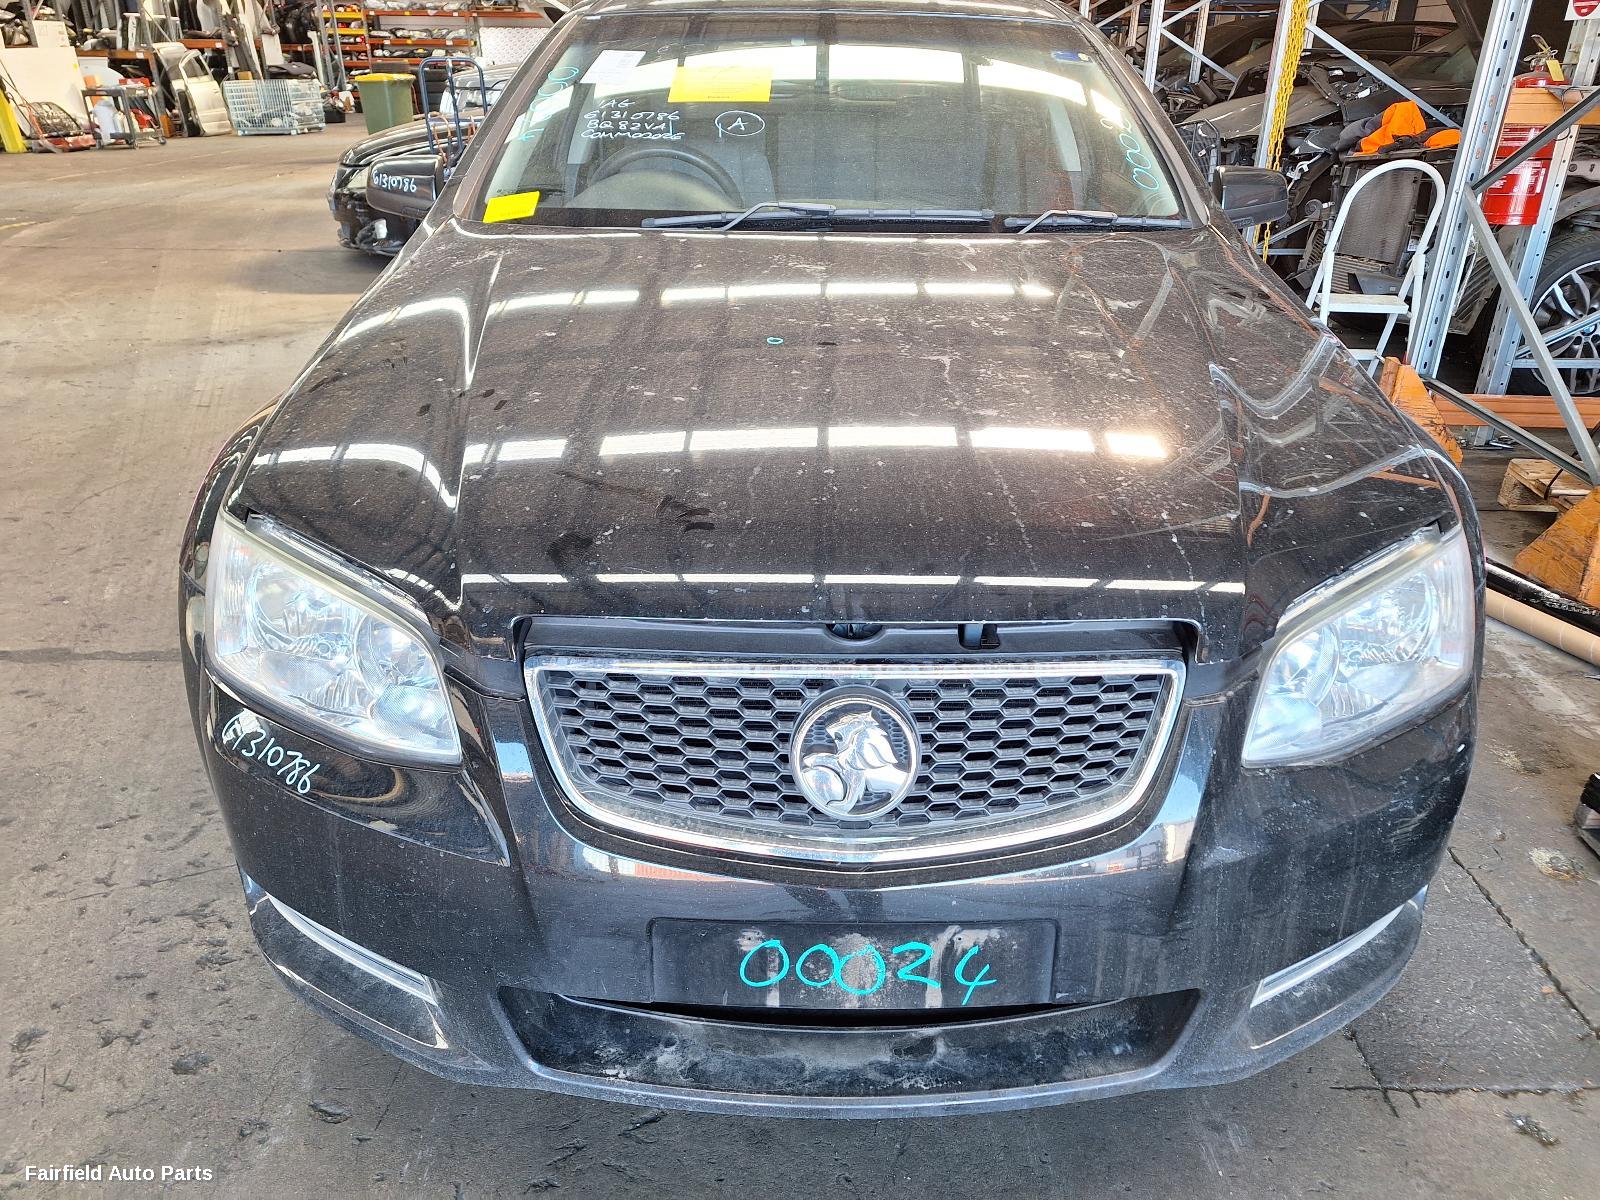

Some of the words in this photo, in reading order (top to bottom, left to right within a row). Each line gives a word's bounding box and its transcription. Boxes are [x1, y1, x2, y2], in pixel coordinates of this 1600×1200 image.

[584, 110, 681, 121] 61310786
[372, 169, 417, 193] 61310786
[739, 939, 997, 1006] 00024
